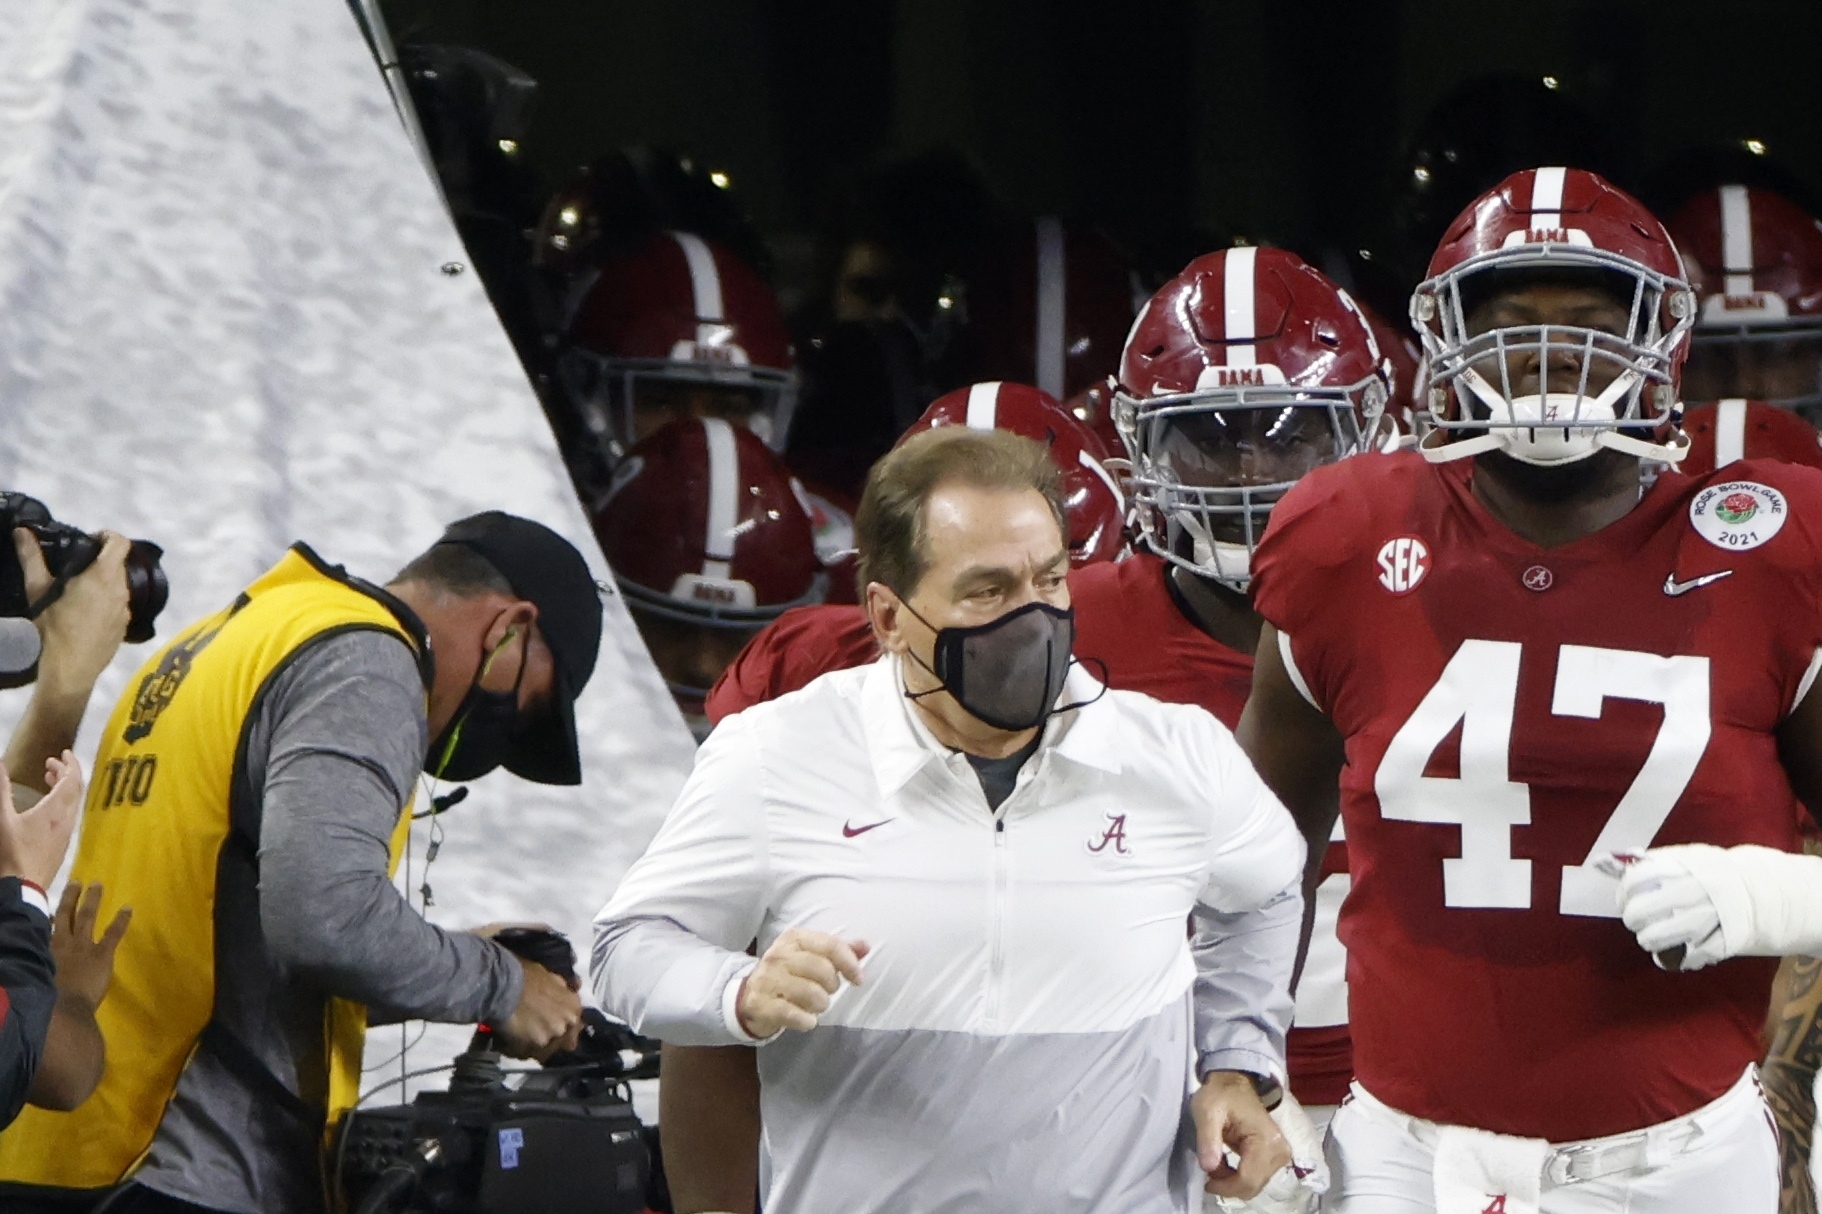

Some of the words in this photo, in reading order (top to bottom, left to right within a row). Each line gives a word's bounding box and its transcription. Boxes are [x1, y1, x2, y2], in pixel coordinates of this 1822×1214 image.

[1525, 227, 1568, 243] BAMA
[1219, 368, 1264, 387] BAMA
[1694, 490, 1717, 516] ROSE
[1718, 484, 1759, 493] BOWL
[1761, 489, 1782, 514] GAME
[1718, 531, 1759, 546] 2021
[1376, 537, 1427, 594] SEC
[1373, 638, 1712, 918] 47
[1087, 813, 1128, 854] A
